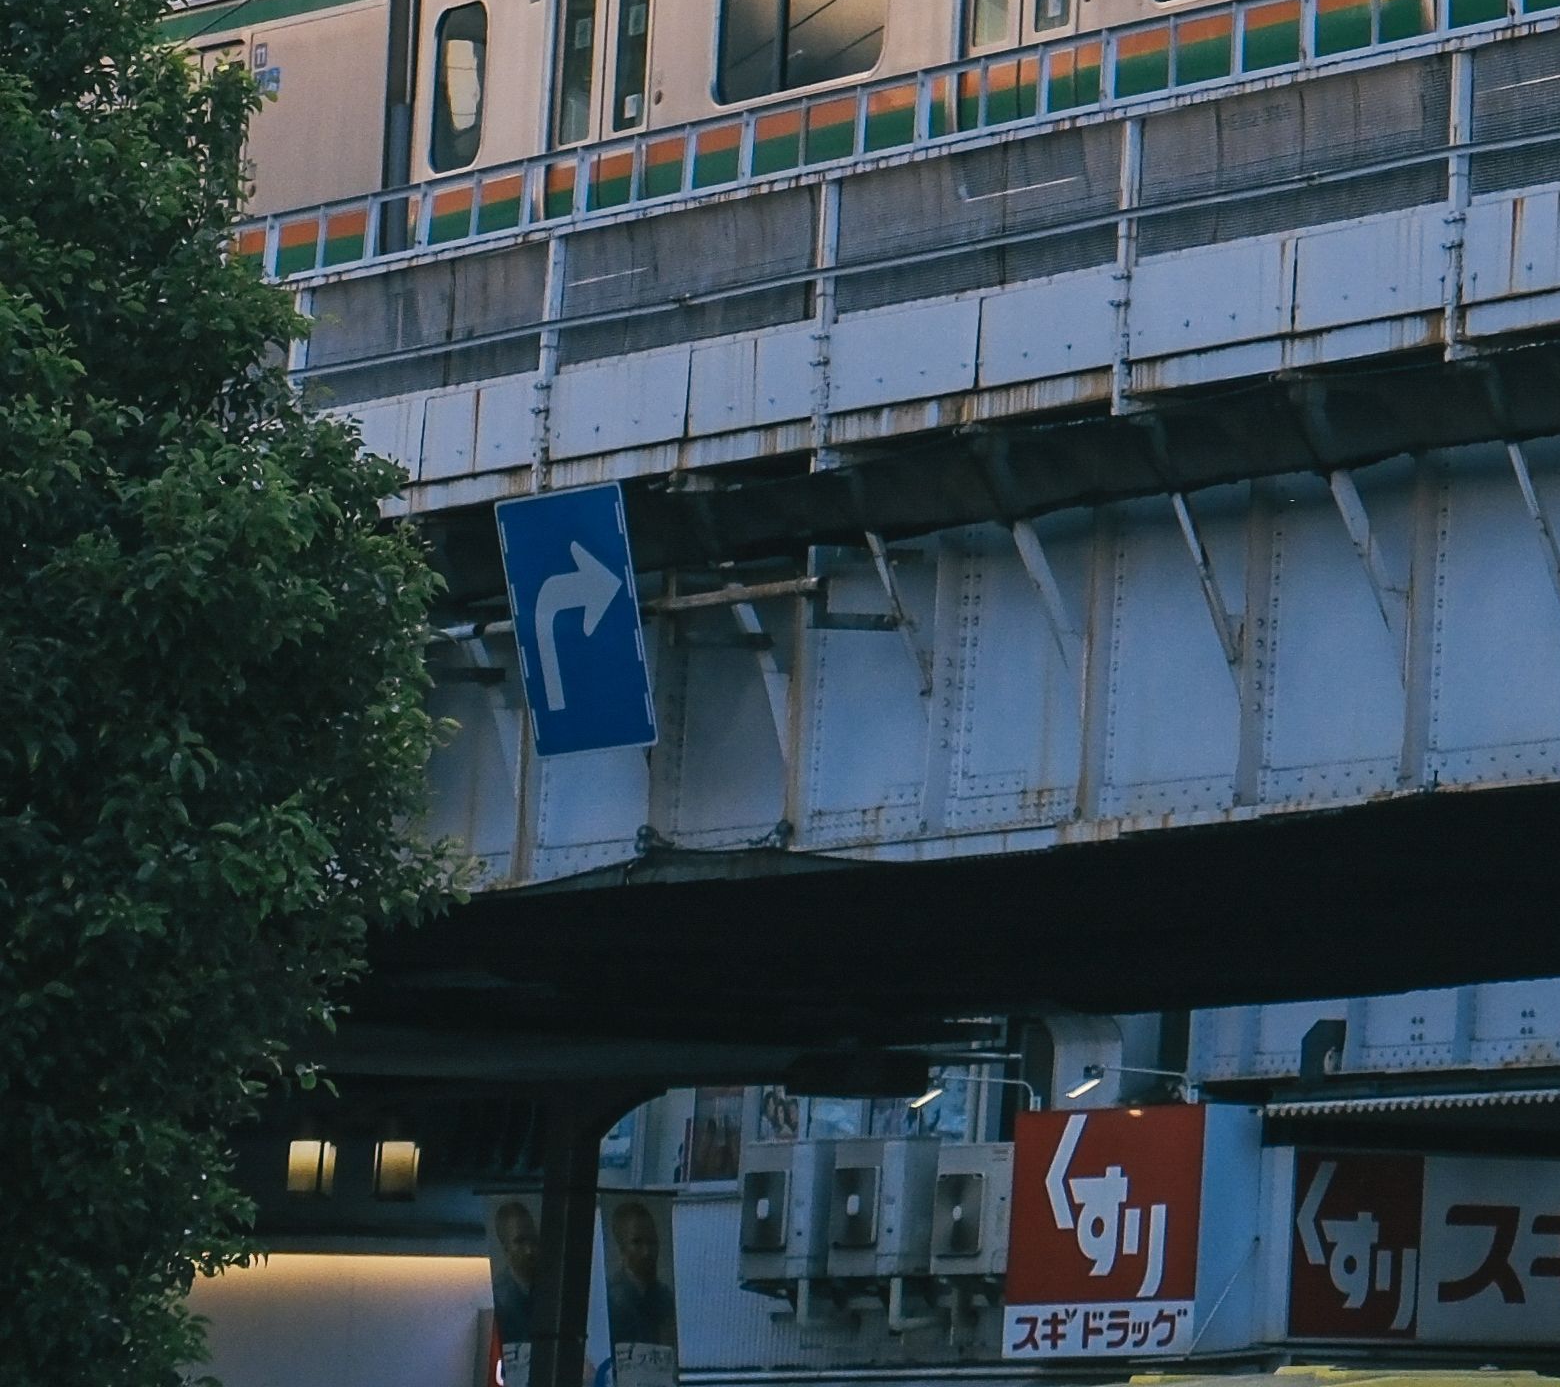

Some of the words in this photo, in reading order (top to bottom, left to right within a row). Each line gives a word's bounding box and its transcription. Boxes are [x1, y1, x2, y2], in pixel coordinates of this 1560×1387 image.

[1045, 1114, 1167, 1298] くすり
[1297, 1161, 1418, 1331] くすり
[1012, 1308, 1188, 1351] スギドラッグ
